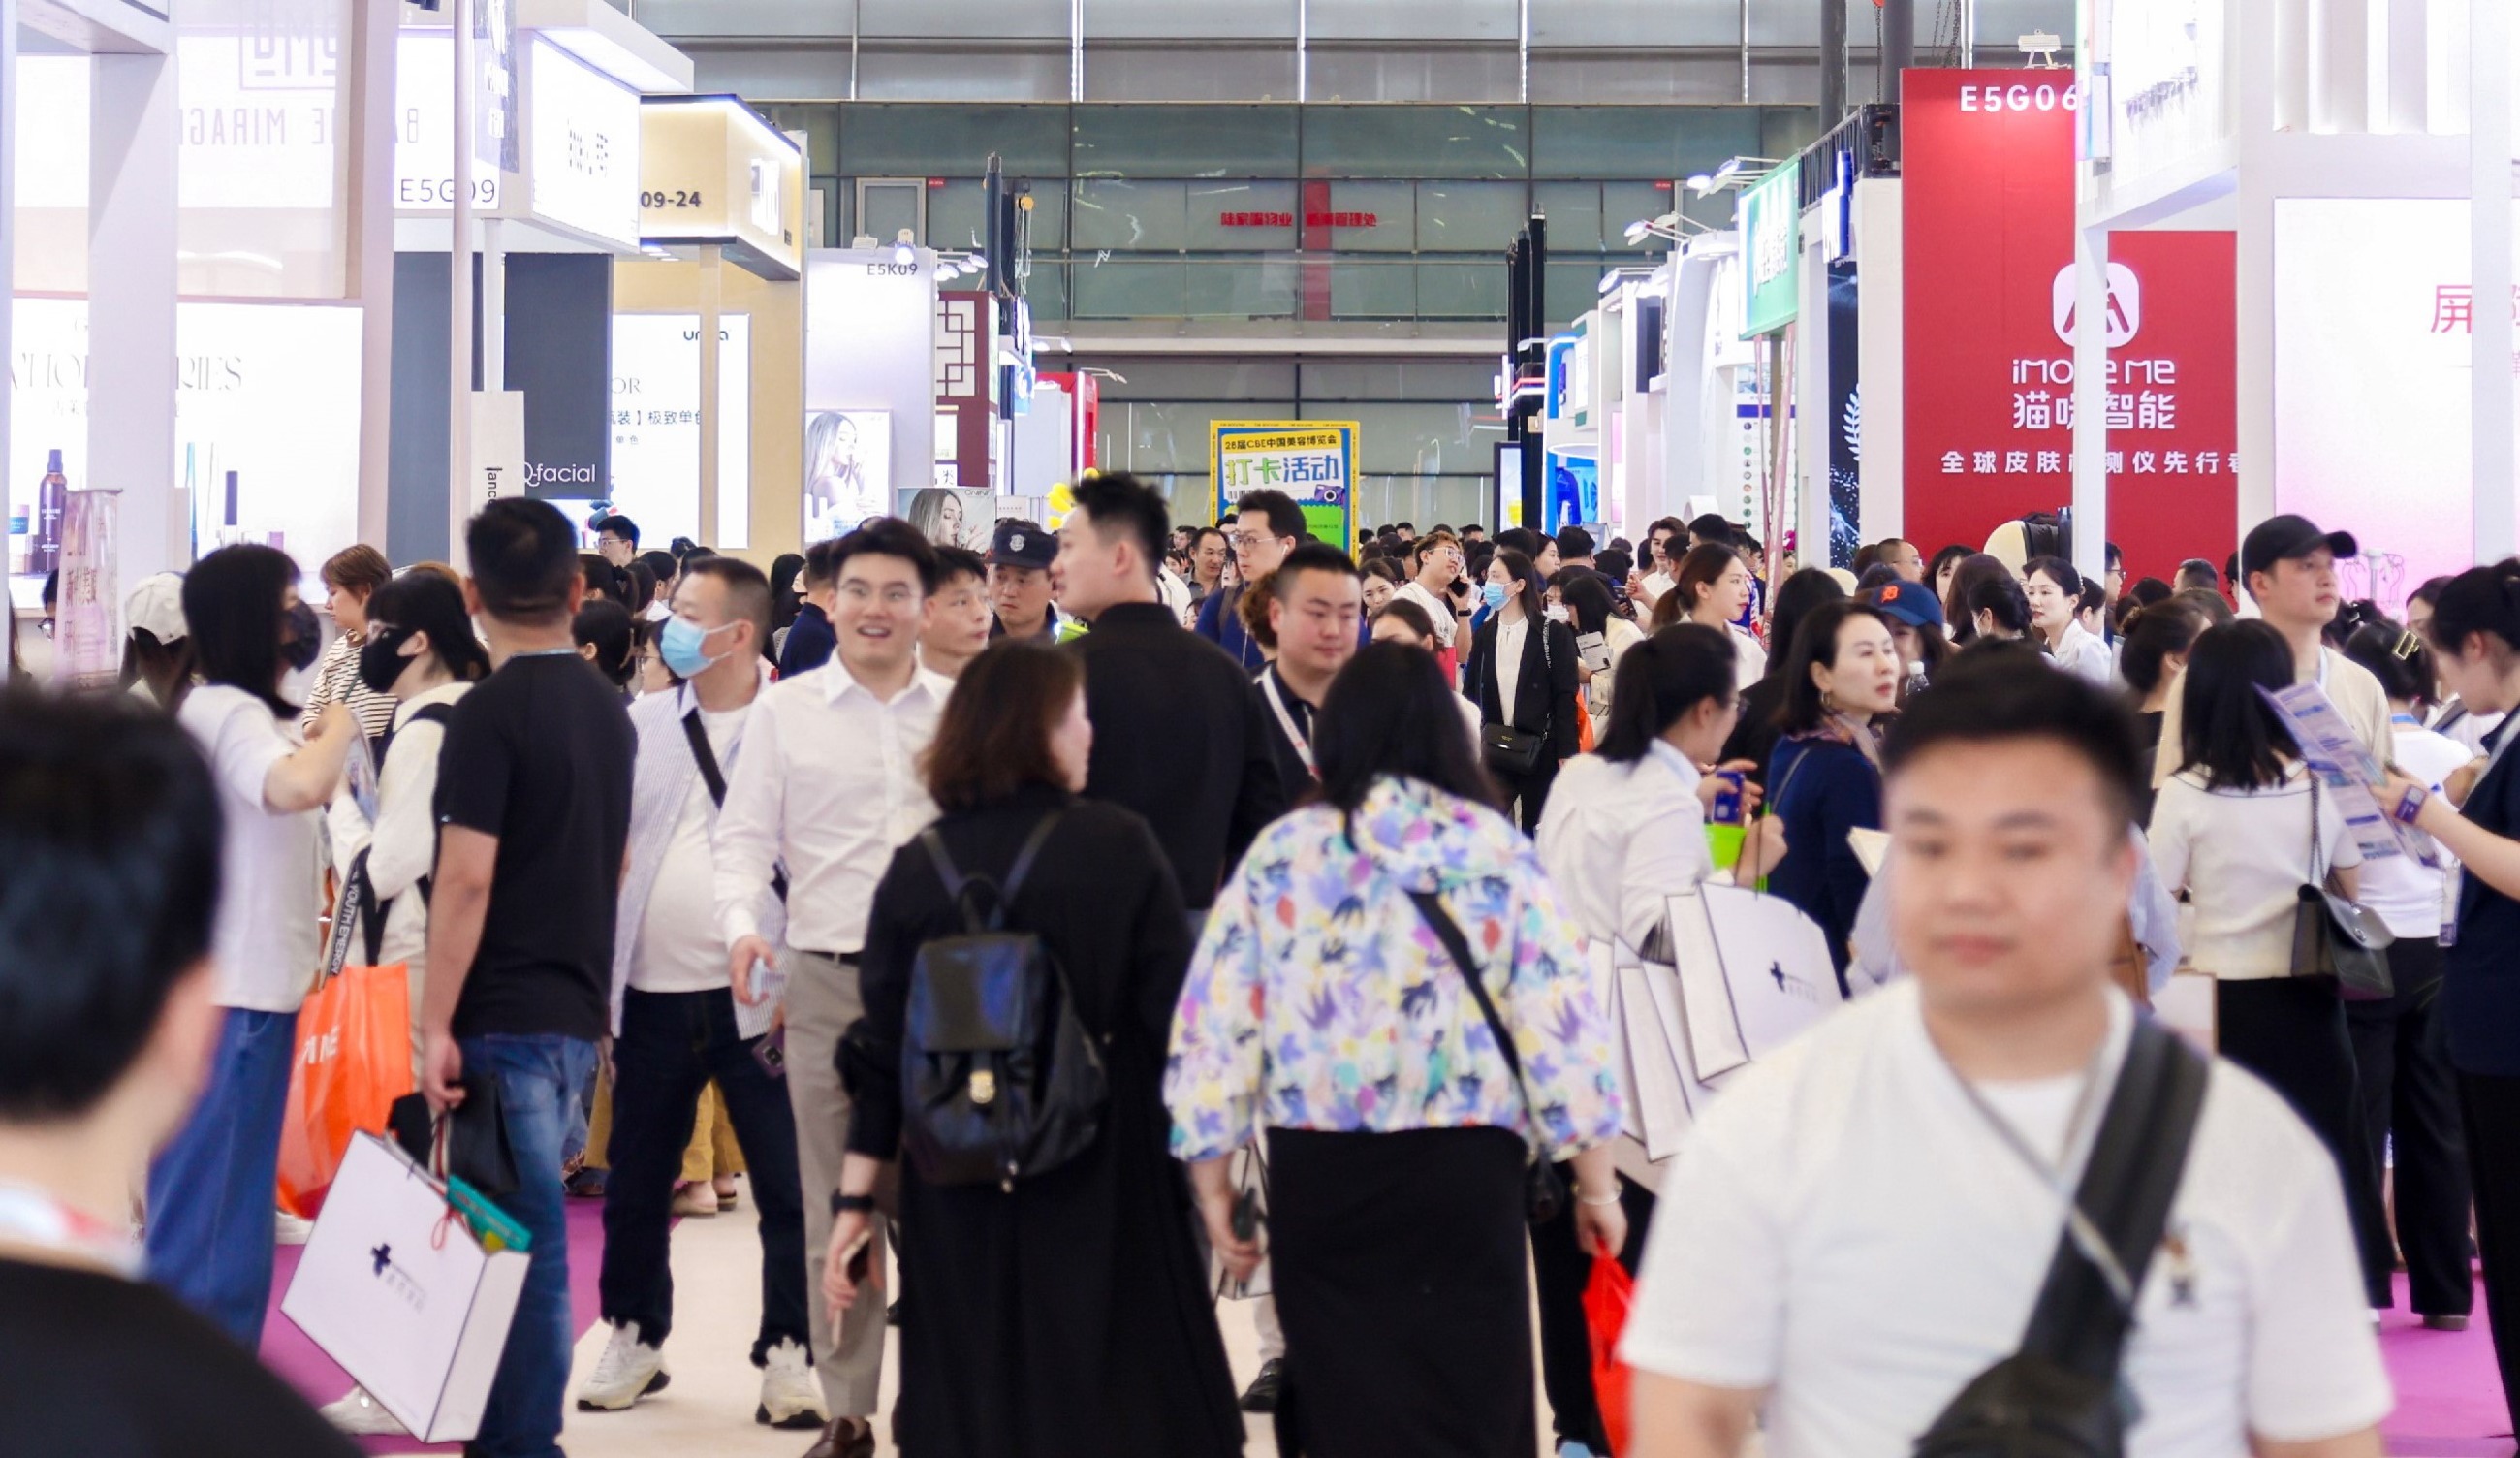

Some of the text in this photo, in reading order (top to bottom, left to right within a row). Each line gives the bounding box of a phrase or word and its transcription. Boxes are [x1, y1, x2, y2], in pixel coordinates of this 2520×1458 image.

[1960, 84, 2079, 112] E5G06
[400, 179, 495, 203] E5G9
[867, 263, 918, 276] E5K09
[1225, 454, 1339, 486] 打卡活动
[1941, 451, 2238, 474] 全球皮肤测仪先行
[340, 884, 359, 925] YOUTH
